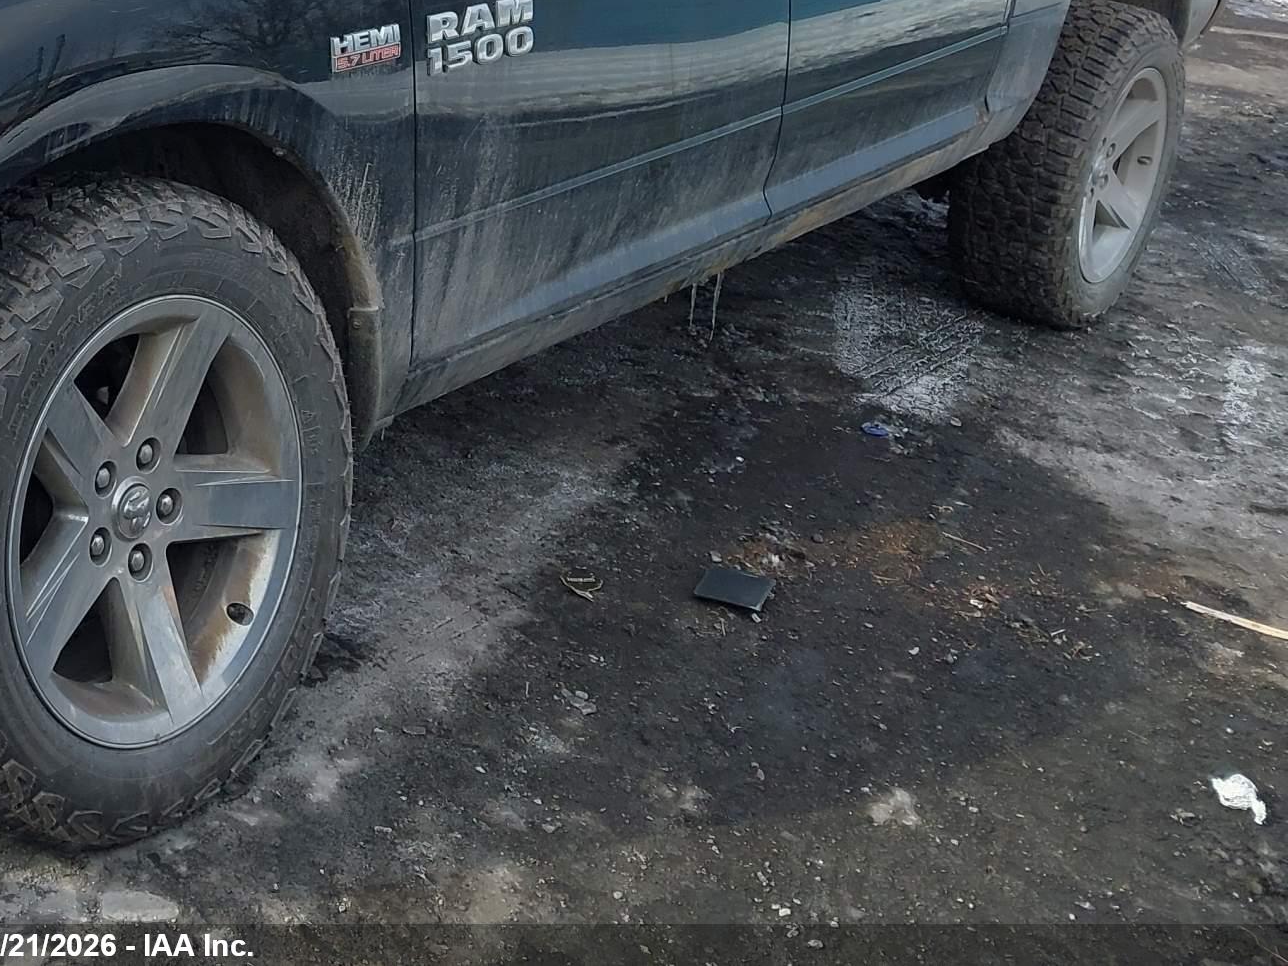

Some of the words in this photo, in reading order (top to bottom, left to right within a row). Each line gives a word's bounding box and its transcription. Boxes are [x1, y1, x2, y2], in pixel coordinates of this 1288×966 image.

[330, 23, 401, 56] HEMI
[426, 26, 534, 76] 1500
[336, 54, 360, 70] 5.7
[361, 44, 400, 63] LITER
